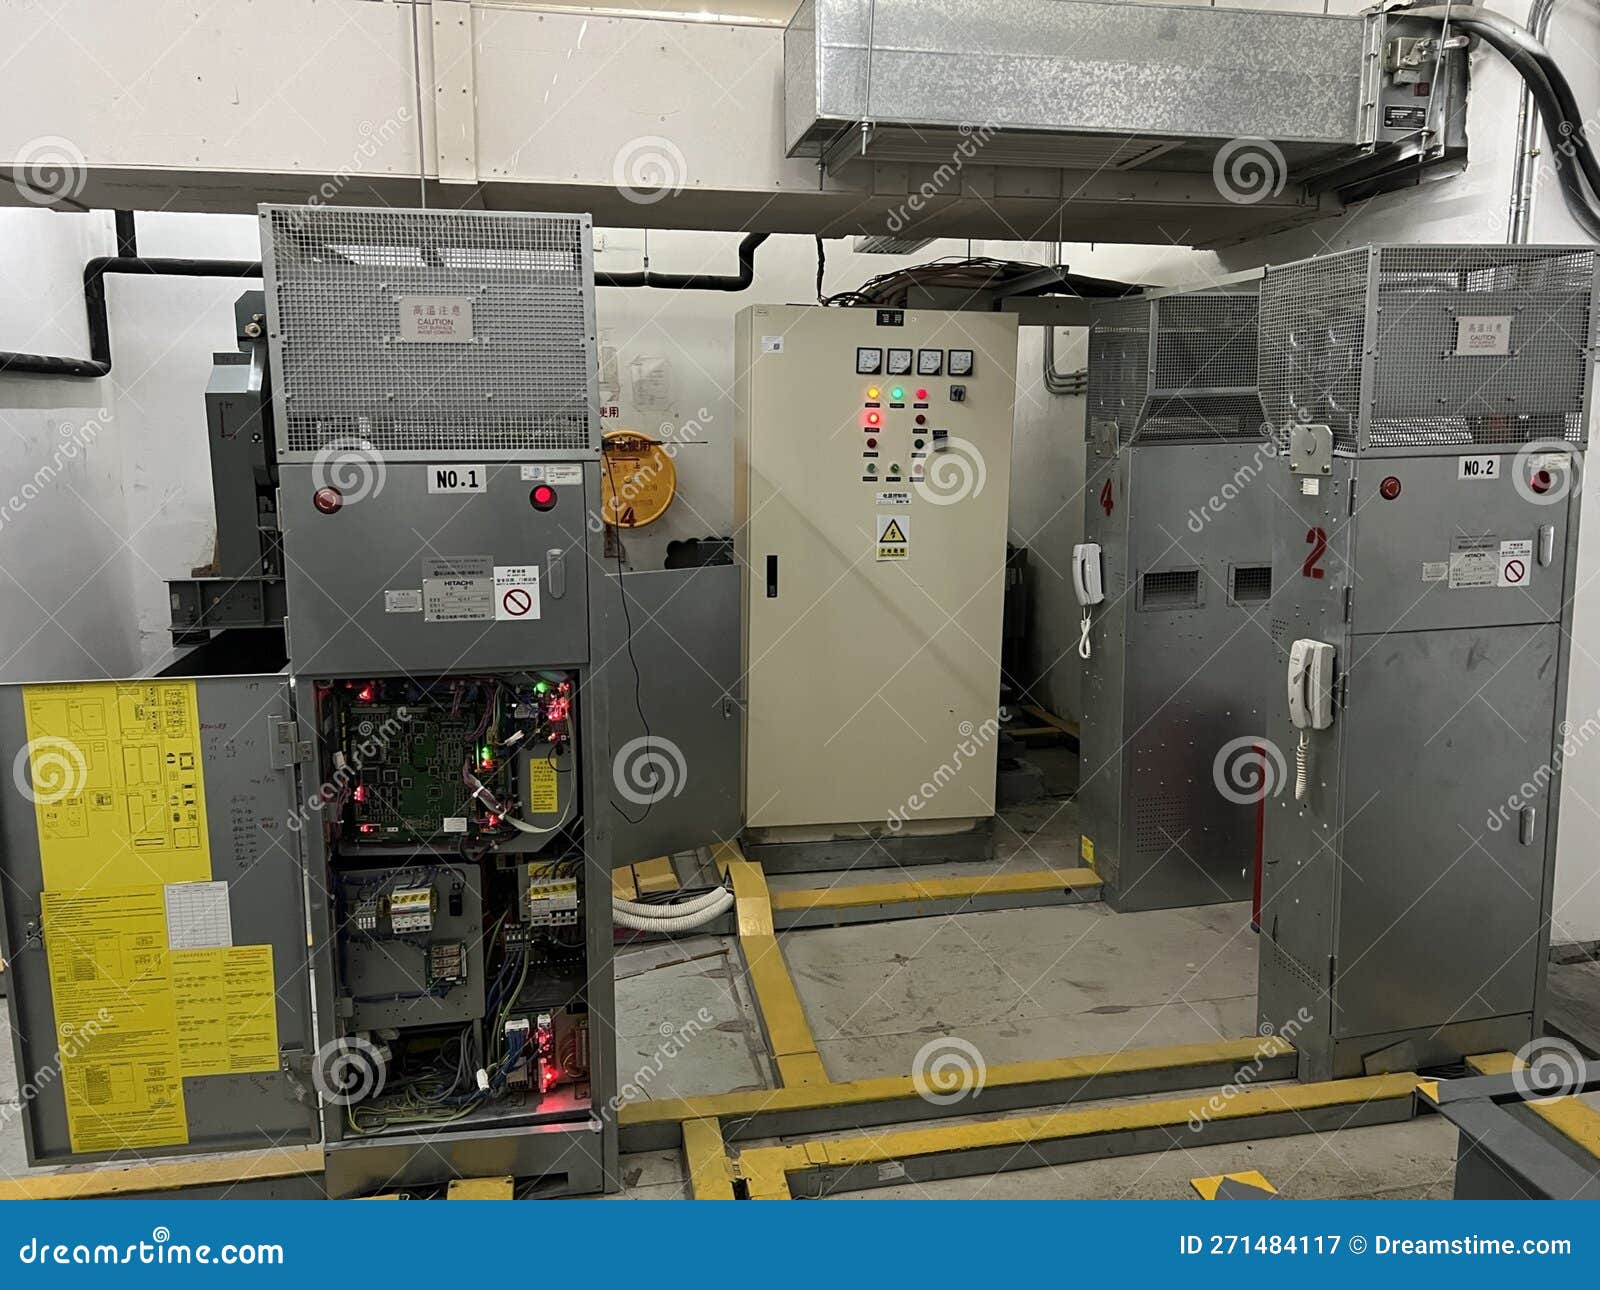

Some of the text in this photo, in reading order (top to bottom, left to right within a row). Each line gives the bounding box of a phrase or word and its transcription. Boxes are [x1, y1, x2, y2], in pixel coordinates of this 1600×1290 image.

[417, 318, 454, 326] CAUTION
[1464, 460, 1493, 476] NO.2
[436, 470, 479, 489] NO.1
[1101, 478, 1114, 517] 4
[620, 506, 636, 527] 4
[1303, 527, 1327, 579] 2
